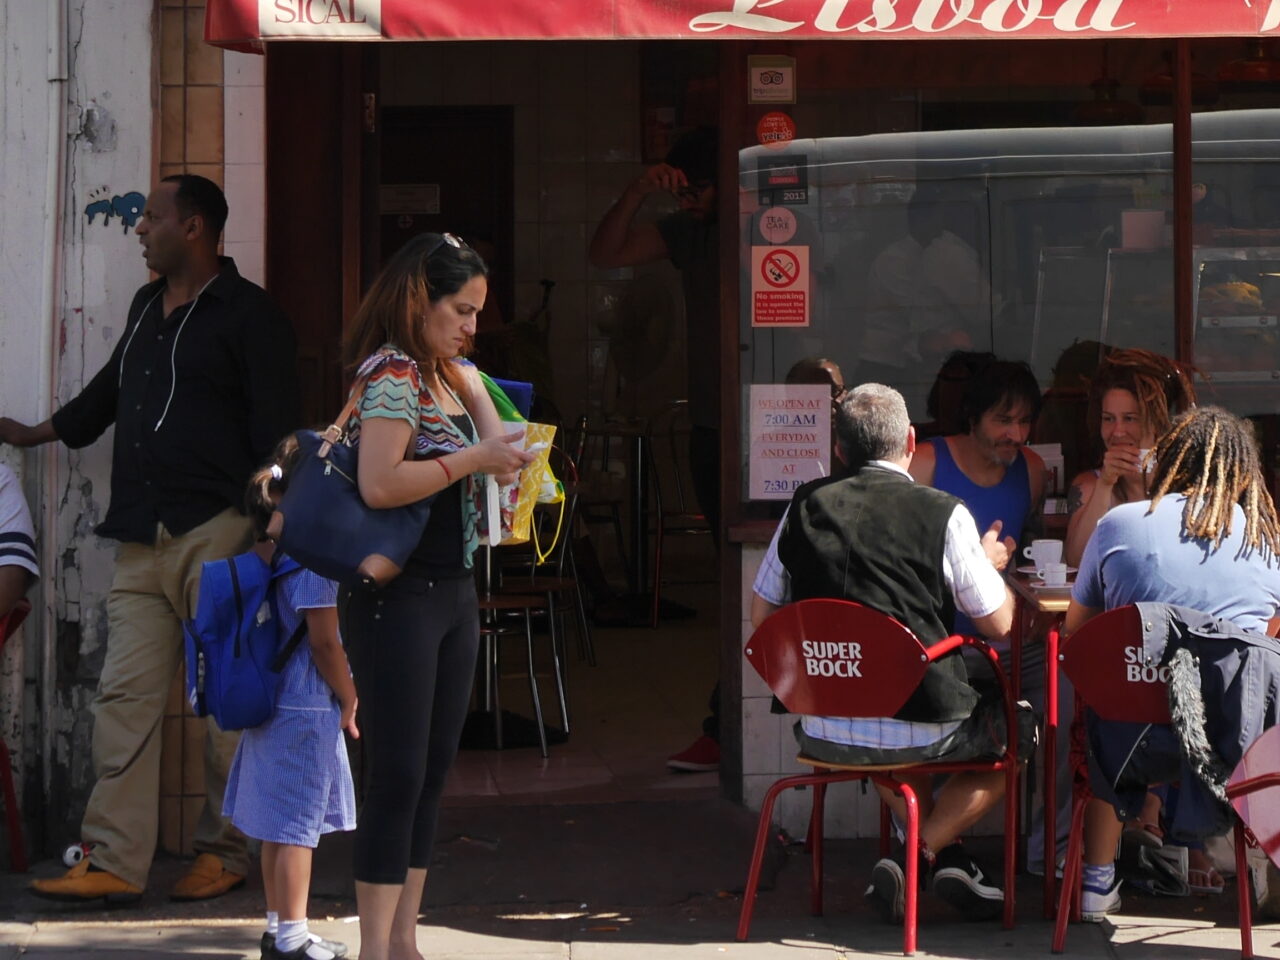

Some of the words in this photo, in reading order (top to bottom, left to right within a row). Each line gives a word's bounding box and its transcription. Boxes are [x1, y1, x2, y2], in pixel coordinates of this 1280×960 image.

[770, 292, 804, 301] smoking
[758, 400, 774, 408] WE
[776, 400, 804, 408] OPEN
[807, 400, 821, 408] AT
[764, 414, 789, 425] 7:00
[792, 414, 817, 425] AM
[761, 433, 817, 442] EVERYDAY
[761, 449, 785, 457] AND
[786, 448, 820, 457] CLOSE
[782, 464, 796, 473] AT
[764, 480, 788, 491] 7:30
[792, 480, 806, 491] P
[802, 640, 863, 660] SUPER
[806, 659, 863, 678] BOCK
